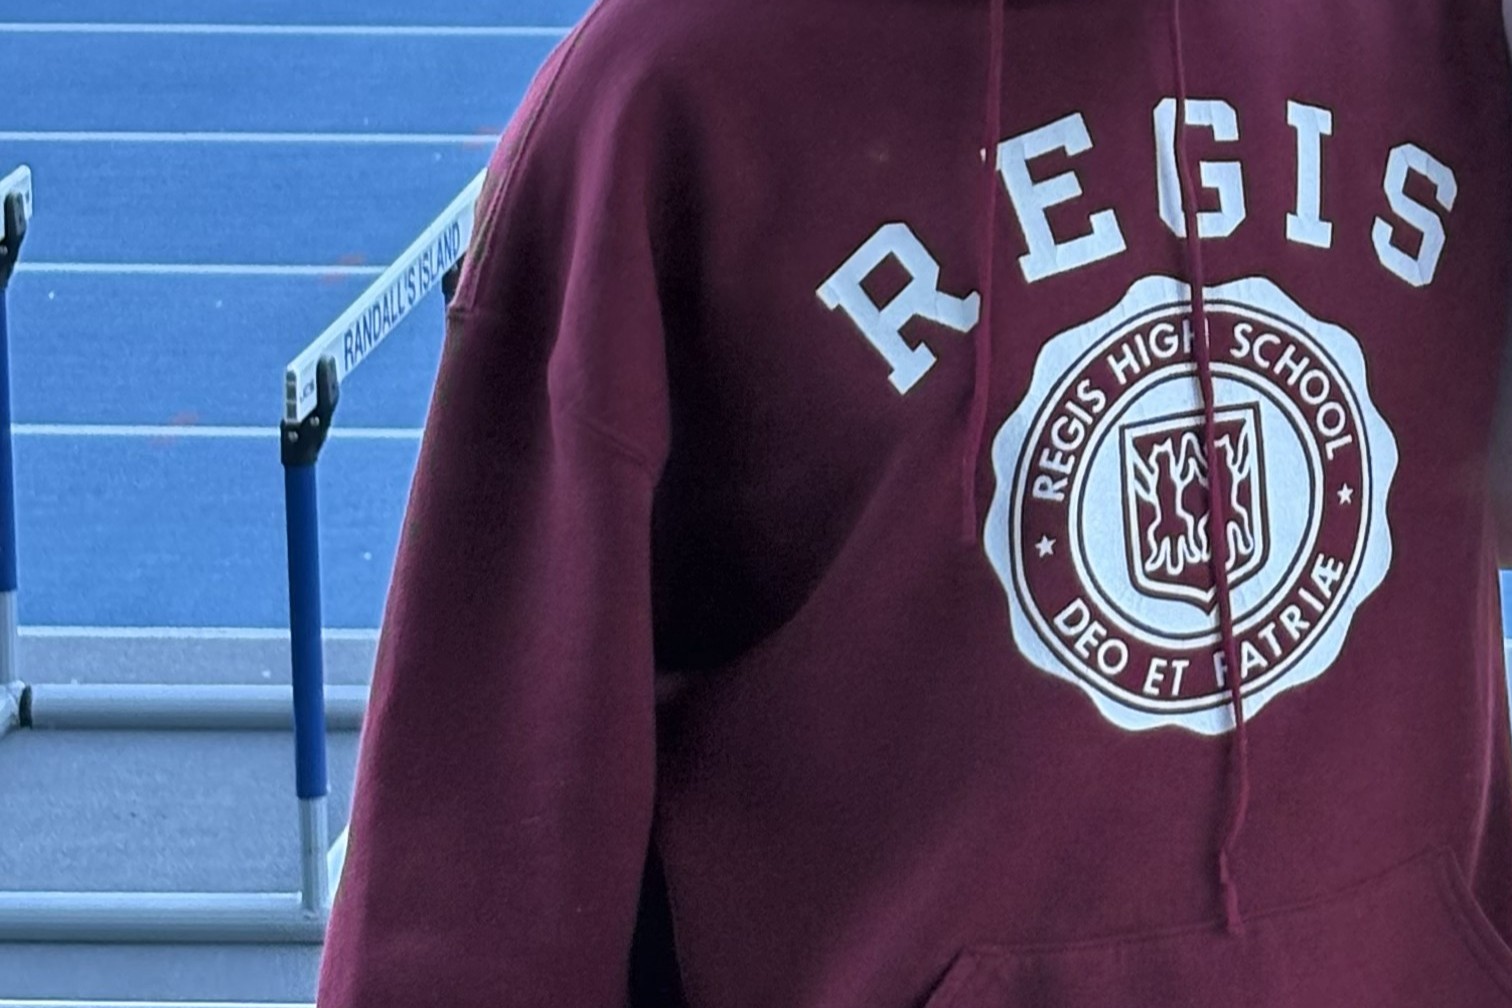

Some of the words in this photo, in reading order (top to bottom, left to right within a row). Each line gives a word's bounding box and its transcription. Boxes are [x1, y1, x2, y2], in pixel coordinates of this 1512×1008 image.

[343, 267, 416, 372] RANDALL'S
[418, 222, 461, 295] ISLAND
[815, 97, 1458, 395] REGIS
[1032, 378, 1107, 503] REGIS
[1229, 321, 1354, 461] SCHOOL
[1052, 597, 1129, 676] DEO
[1142, 658, 1190, 697] ET
